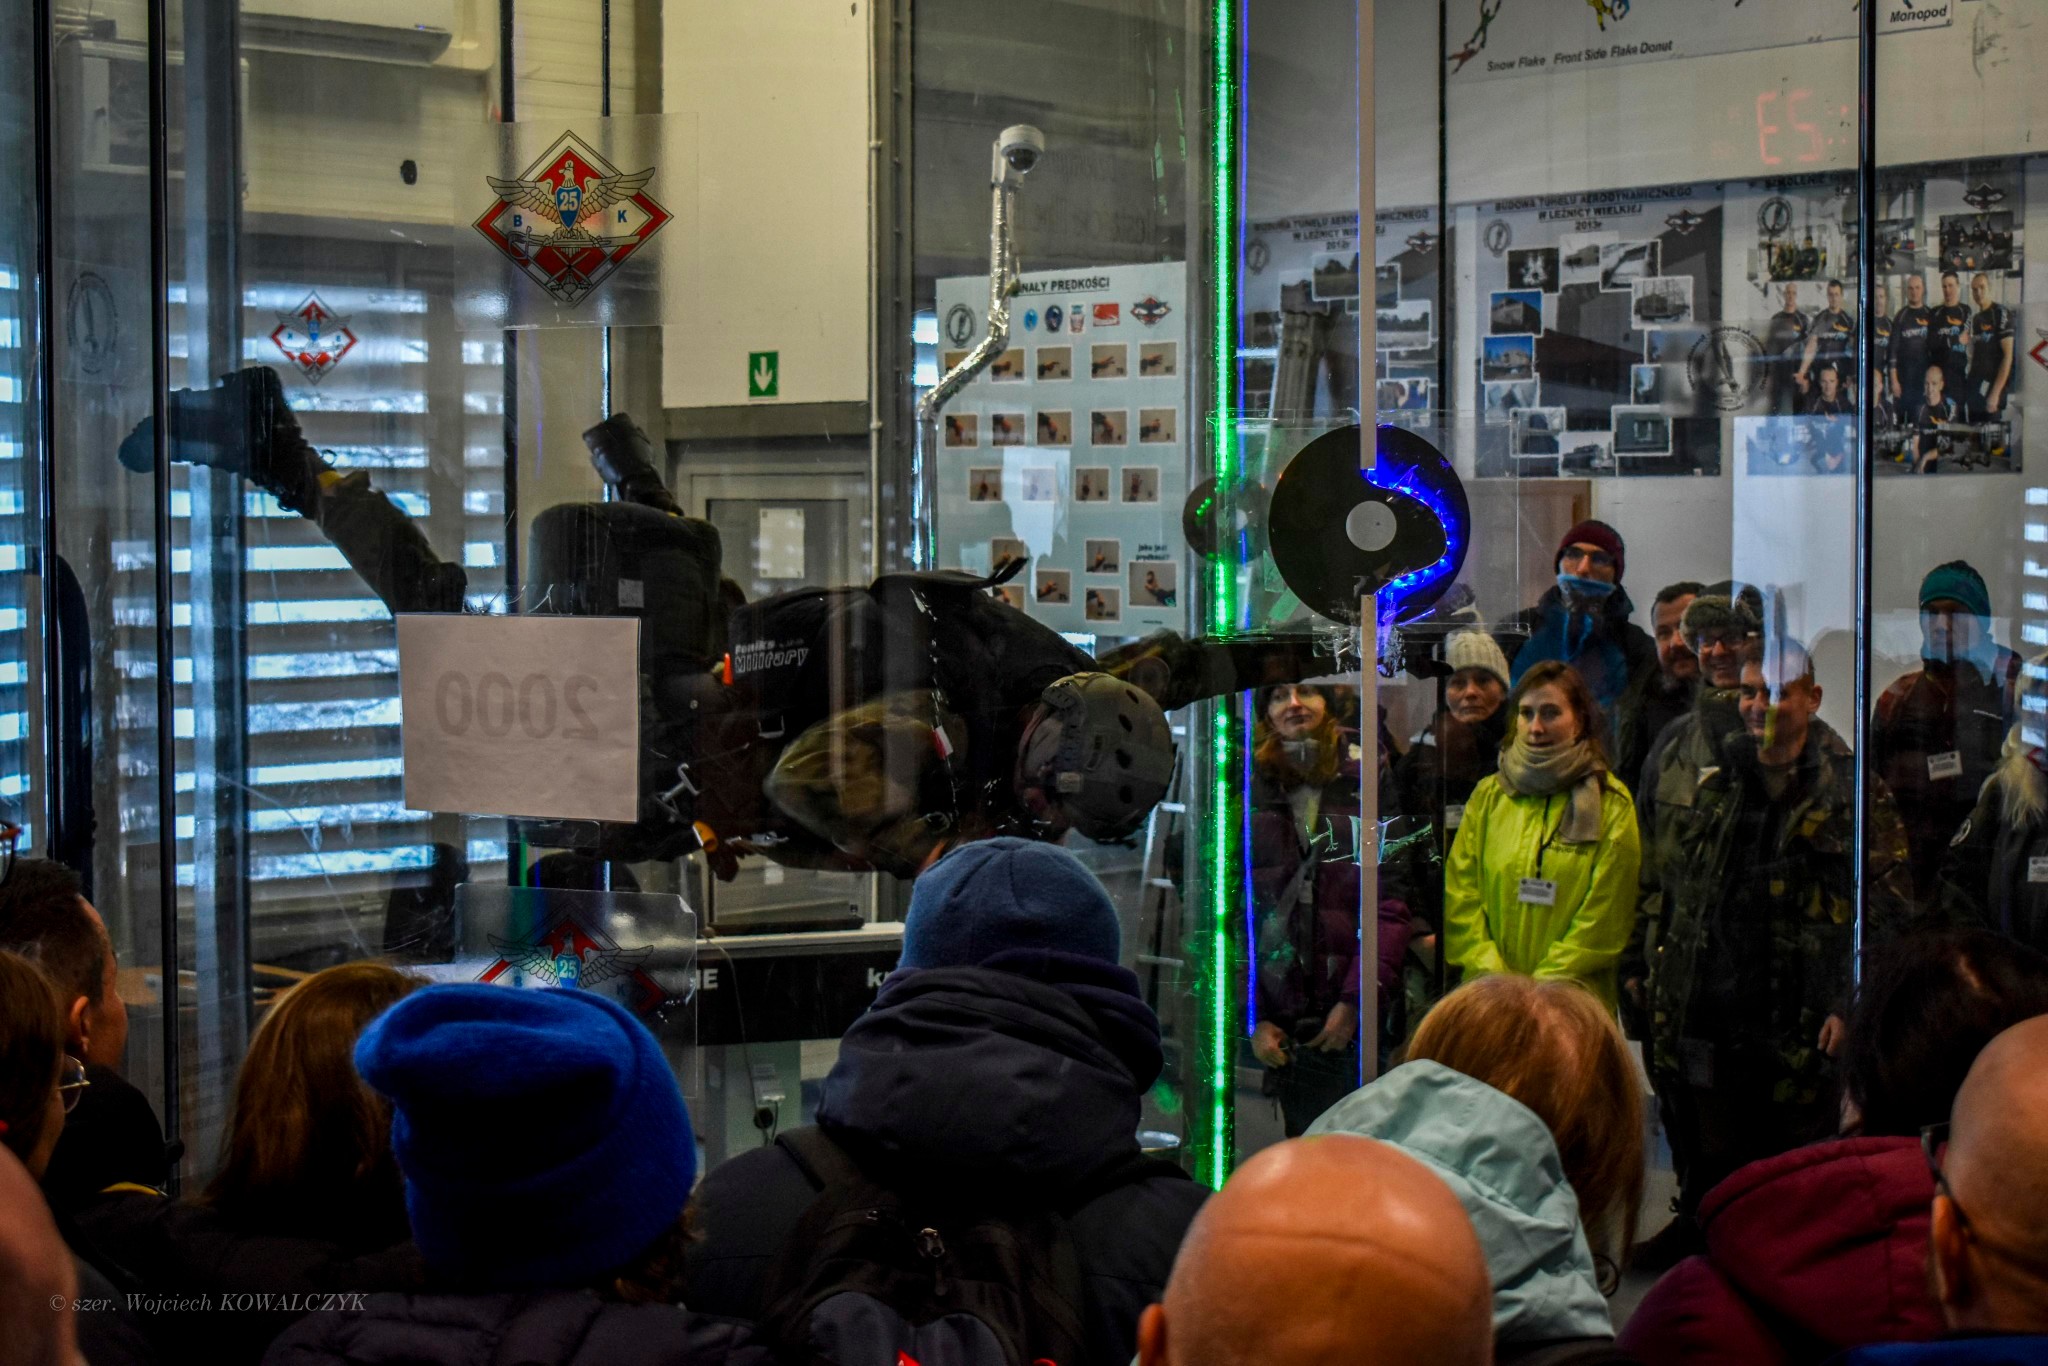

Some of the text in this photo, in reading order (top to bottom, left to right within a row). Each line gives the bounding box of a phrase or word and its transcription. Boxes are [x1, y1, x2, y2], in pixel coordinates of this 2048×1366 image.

[1890, 5, 1948, 23] Monopod
[1553, 40, 1673, 65] Front Side Flake Donut
[1487, 56, 1546, 72] Snow Flake
[558, 190, 578, 212] 25
[513, 209, 628, 228] B K
[1020, 276, 1110, 293] NAŁY PRĘDKOŚCI
[559, 959, 578, 980] 25
